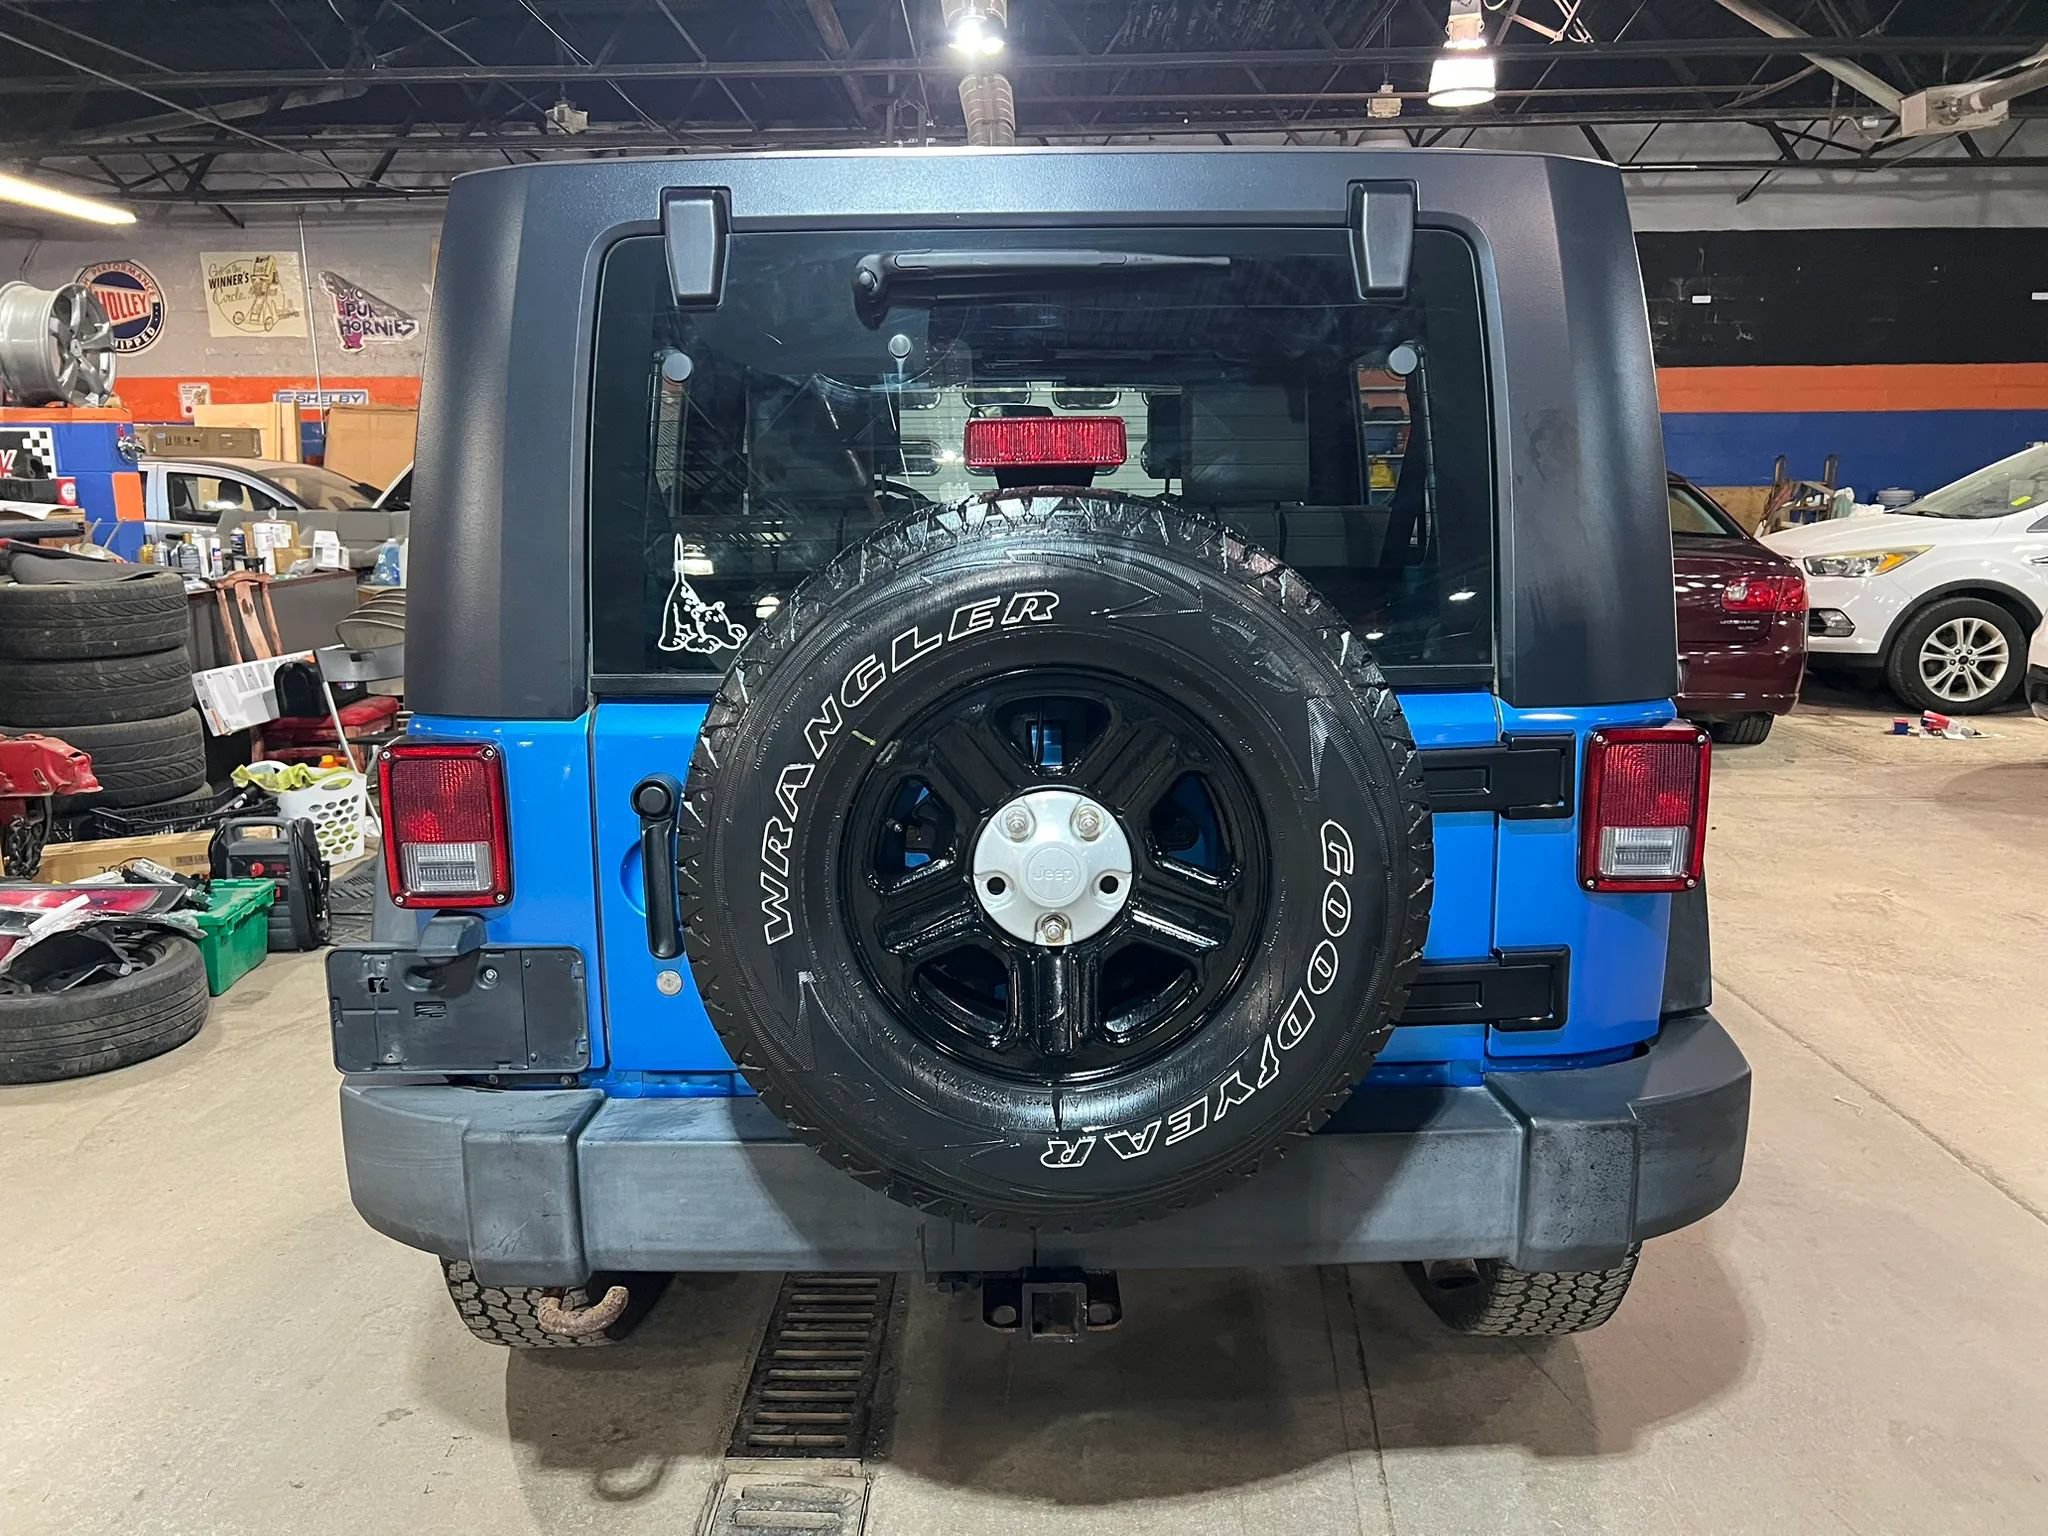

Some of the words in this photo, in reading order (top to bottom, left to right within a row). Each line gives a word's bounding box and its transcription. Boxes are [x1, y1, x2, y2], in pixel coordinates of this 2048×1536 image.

[91, 263, 156, 298] PERFORMANCE
[208, 271, 249, 289] WINNER'S
[296, 394, 361, 404] SHELBY
[760, 590, 1060, 944] WRANGLER
[1032, 866, 1073, 885] Jeep
[1040, 820, 1354, 1168] GOODYEAR
